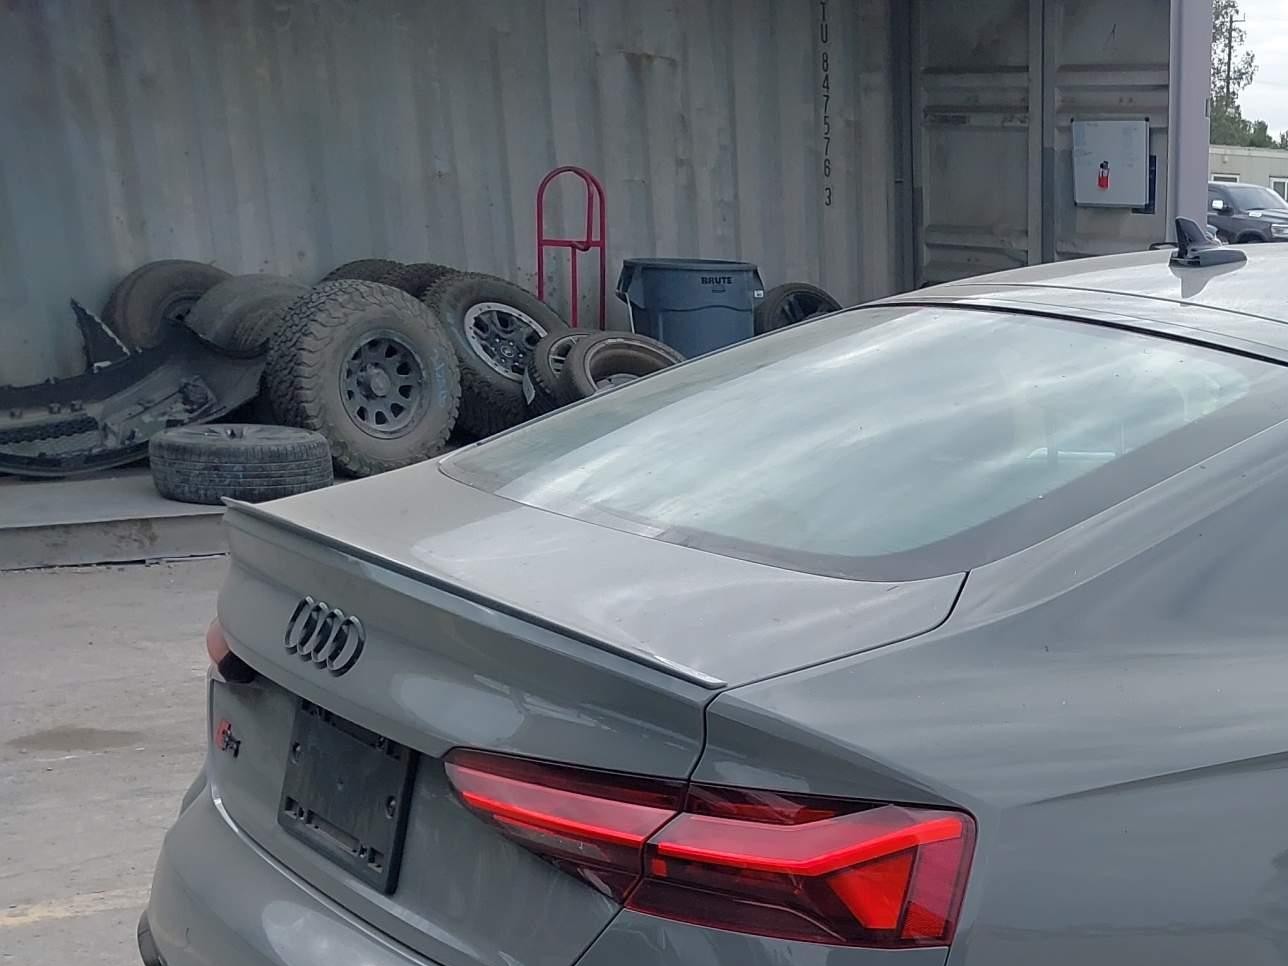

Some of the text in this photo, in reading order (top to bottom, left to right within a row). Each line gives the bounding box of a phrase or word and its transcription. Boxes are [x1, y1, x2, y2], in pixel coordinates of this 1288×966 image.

[822, 52, 831, 177] 847576
[824, 187, 832, 206] 3
[701, 276, 732, 285] BRUTE
